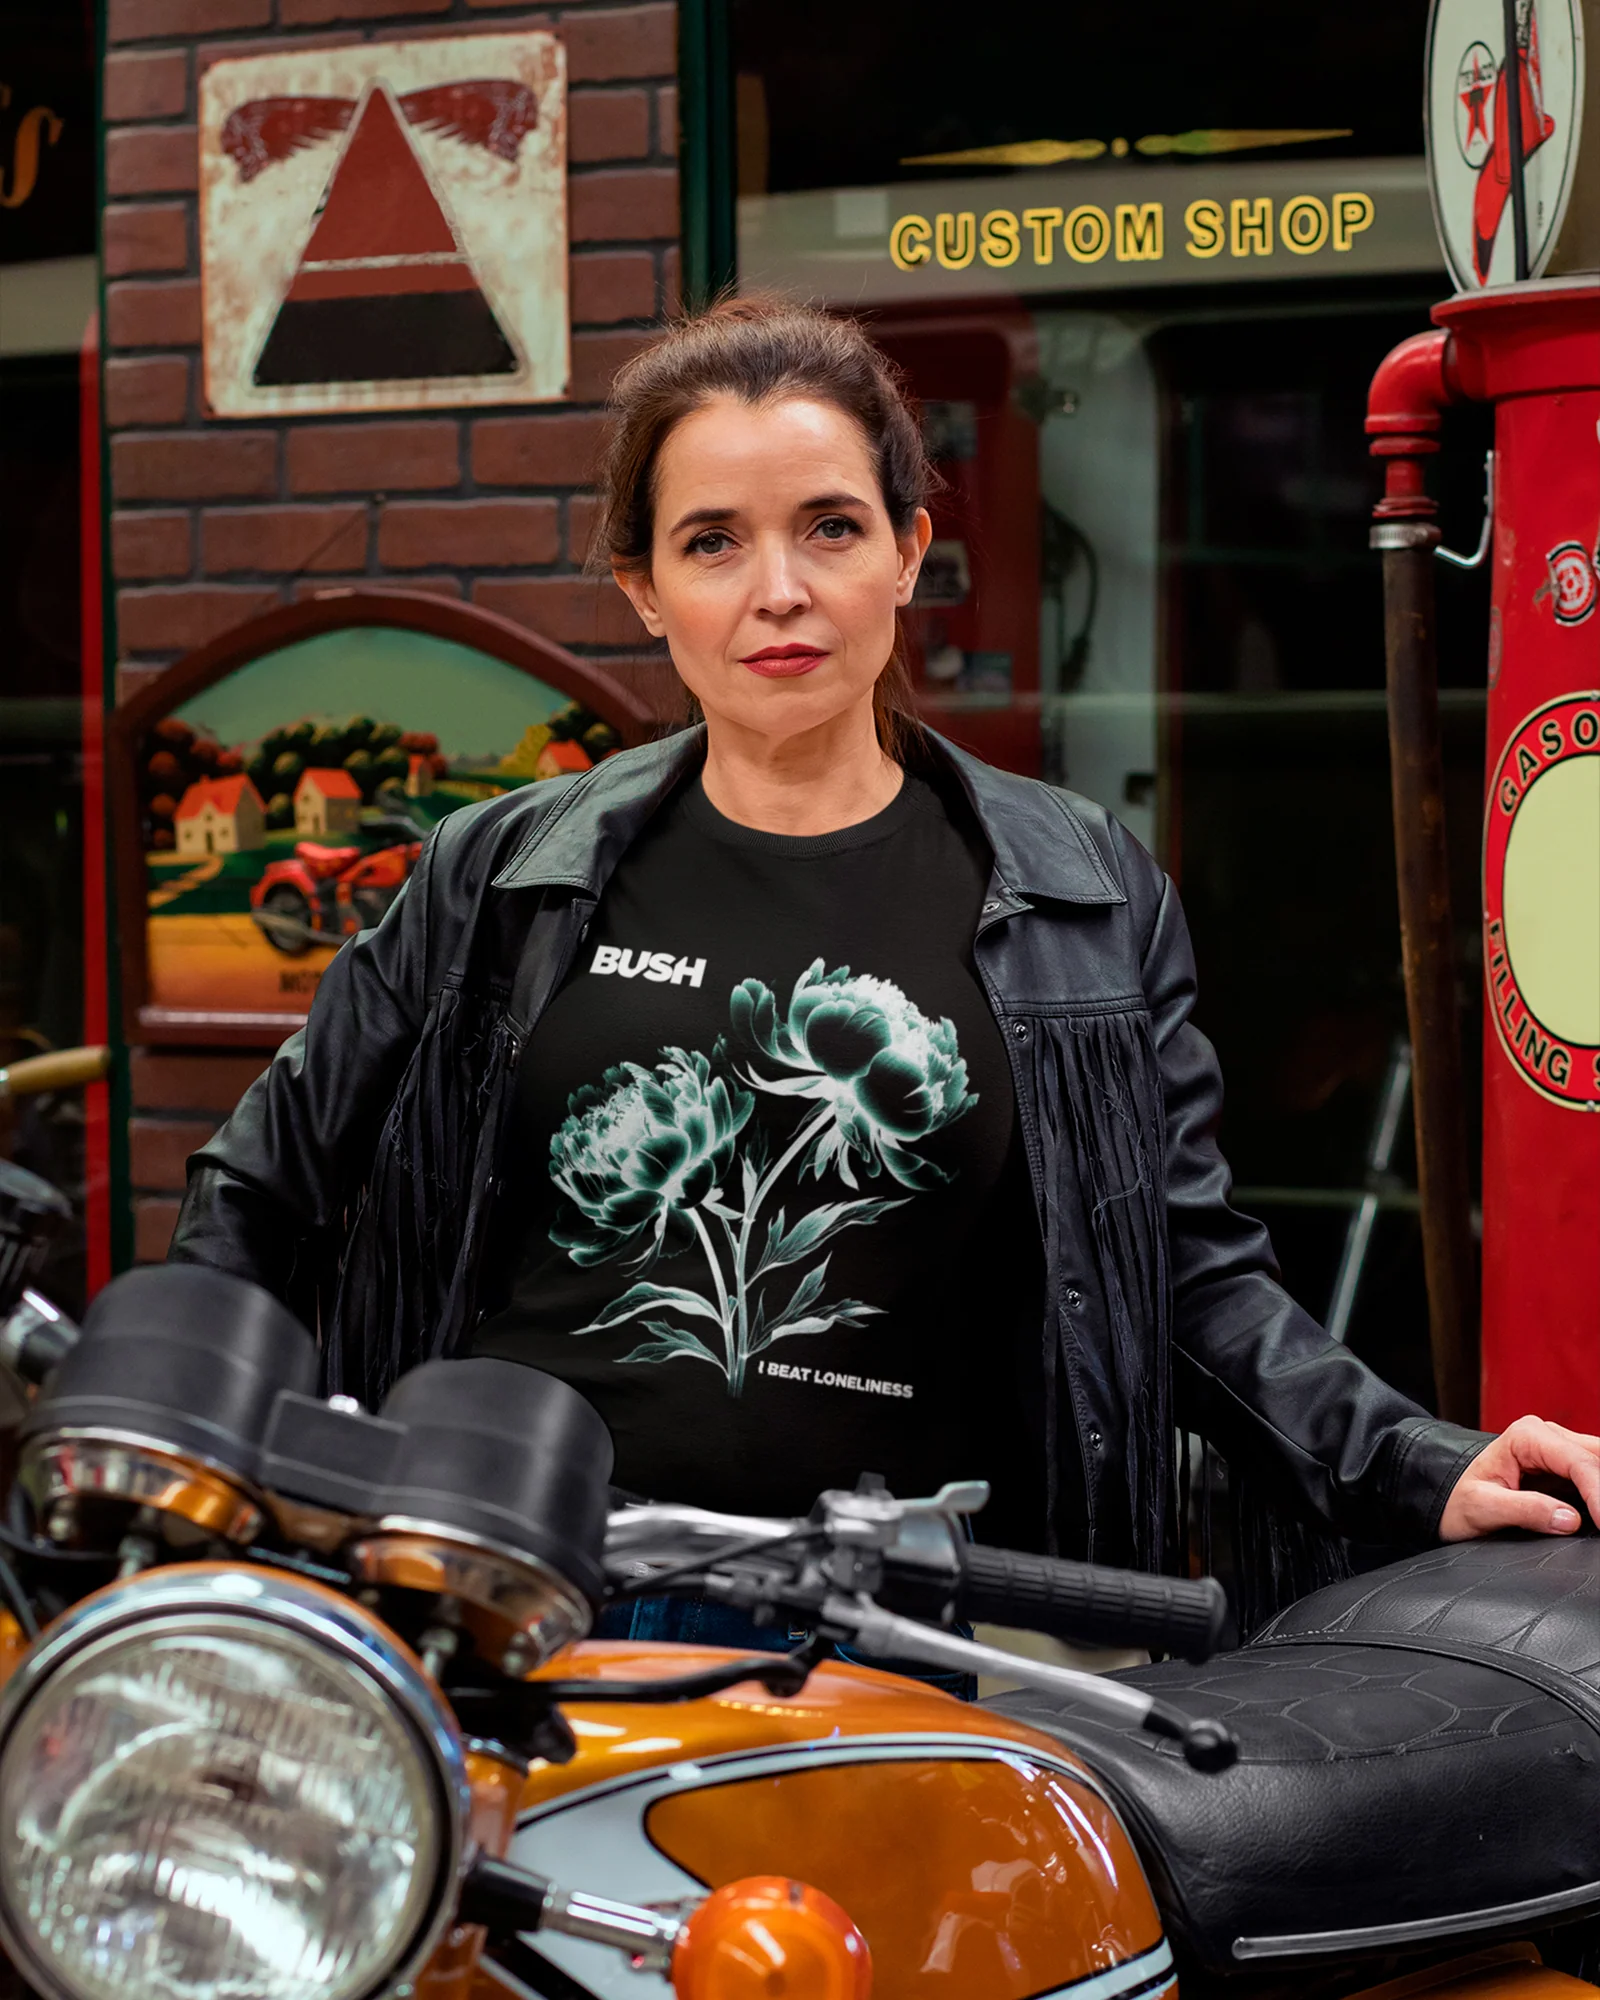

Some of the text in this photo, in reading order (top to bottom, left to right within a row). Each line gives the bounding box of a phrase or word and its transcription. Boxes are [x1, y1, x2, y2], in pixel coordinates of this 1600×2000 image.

[889, 192, 1375, 272] CUSTOM SHOP
[1499, 709, 1600, 816] GASO
[589, 945, 707, 988] BUSH
[1488, 917, 1573, 1090] FILLING
[757, 1360, 914, 1399] I BEAT LONELINESS
